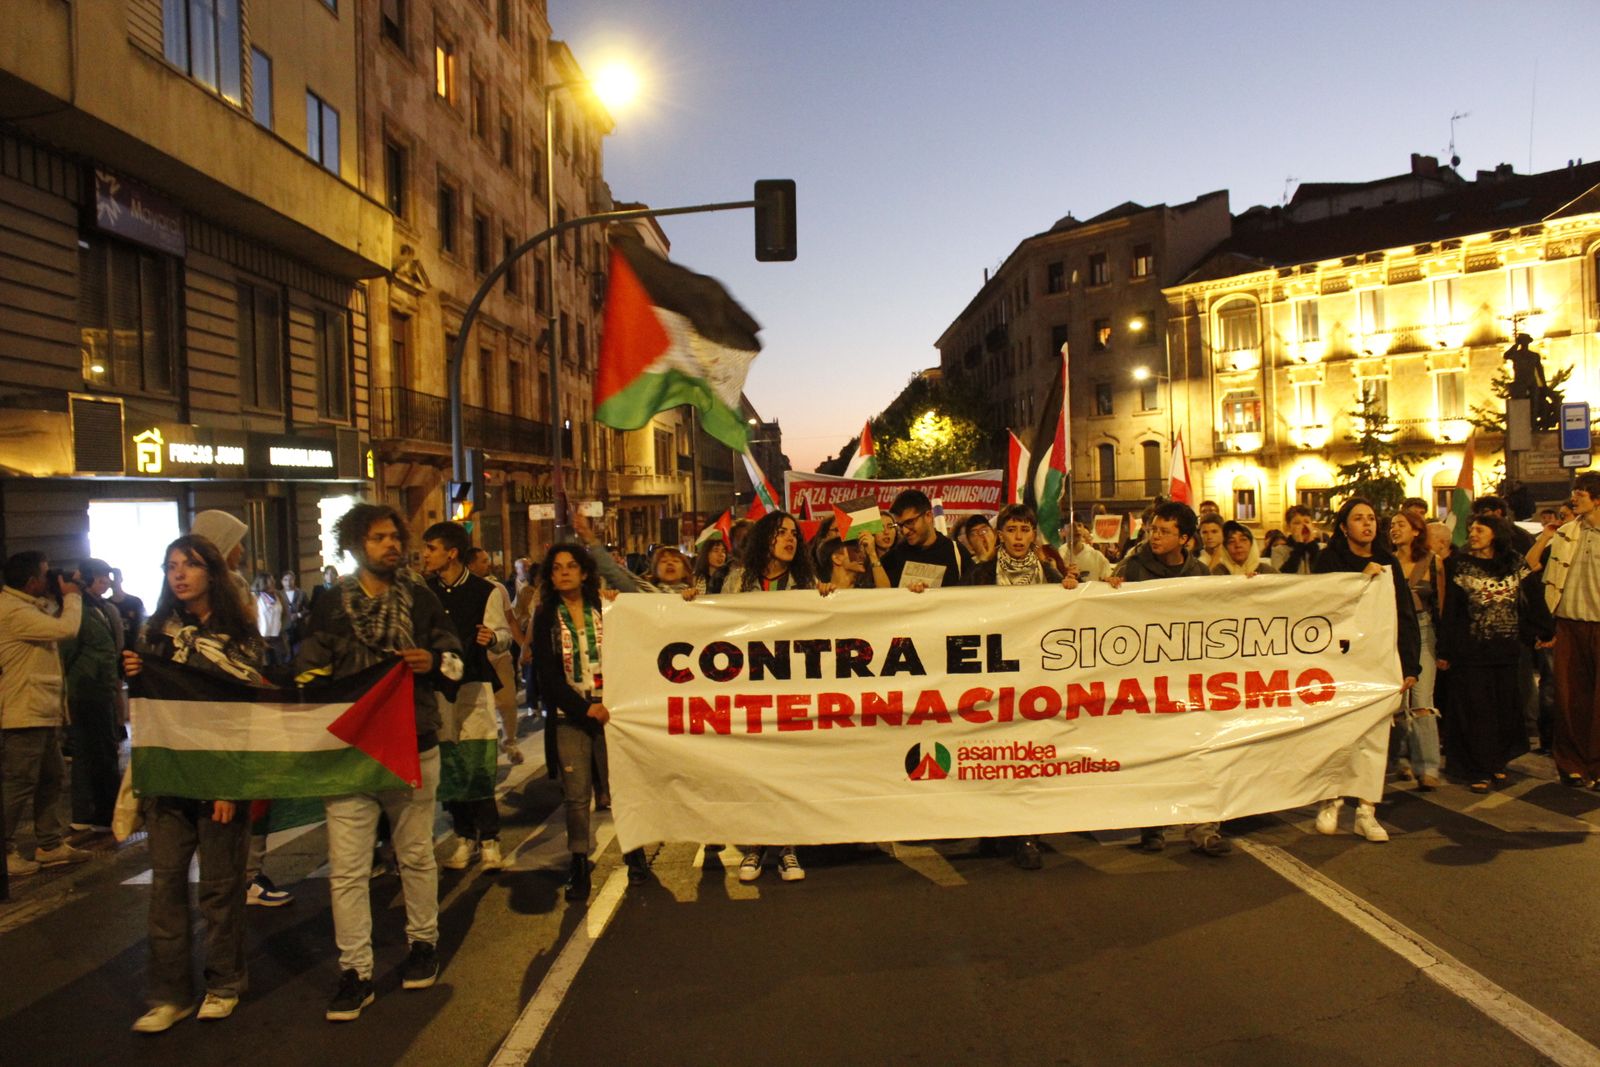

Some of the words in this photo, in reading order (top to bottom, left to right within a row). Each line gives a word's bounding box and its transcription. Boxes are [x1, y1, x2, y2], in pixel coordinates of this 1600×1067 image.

[940, 485, 1000, 504] SIONISMO!
[657, 637, 927, 683] CONTRA
[946, 633, 1020, 675] EL
[1041, 615, 1350, 671] SIONISMO,
[667, 667, 1337, 735] INTERNACIONALISMO
[957, 741, 1057, 761] asamblea
[957, 756, 1121, 780] internacionalista
